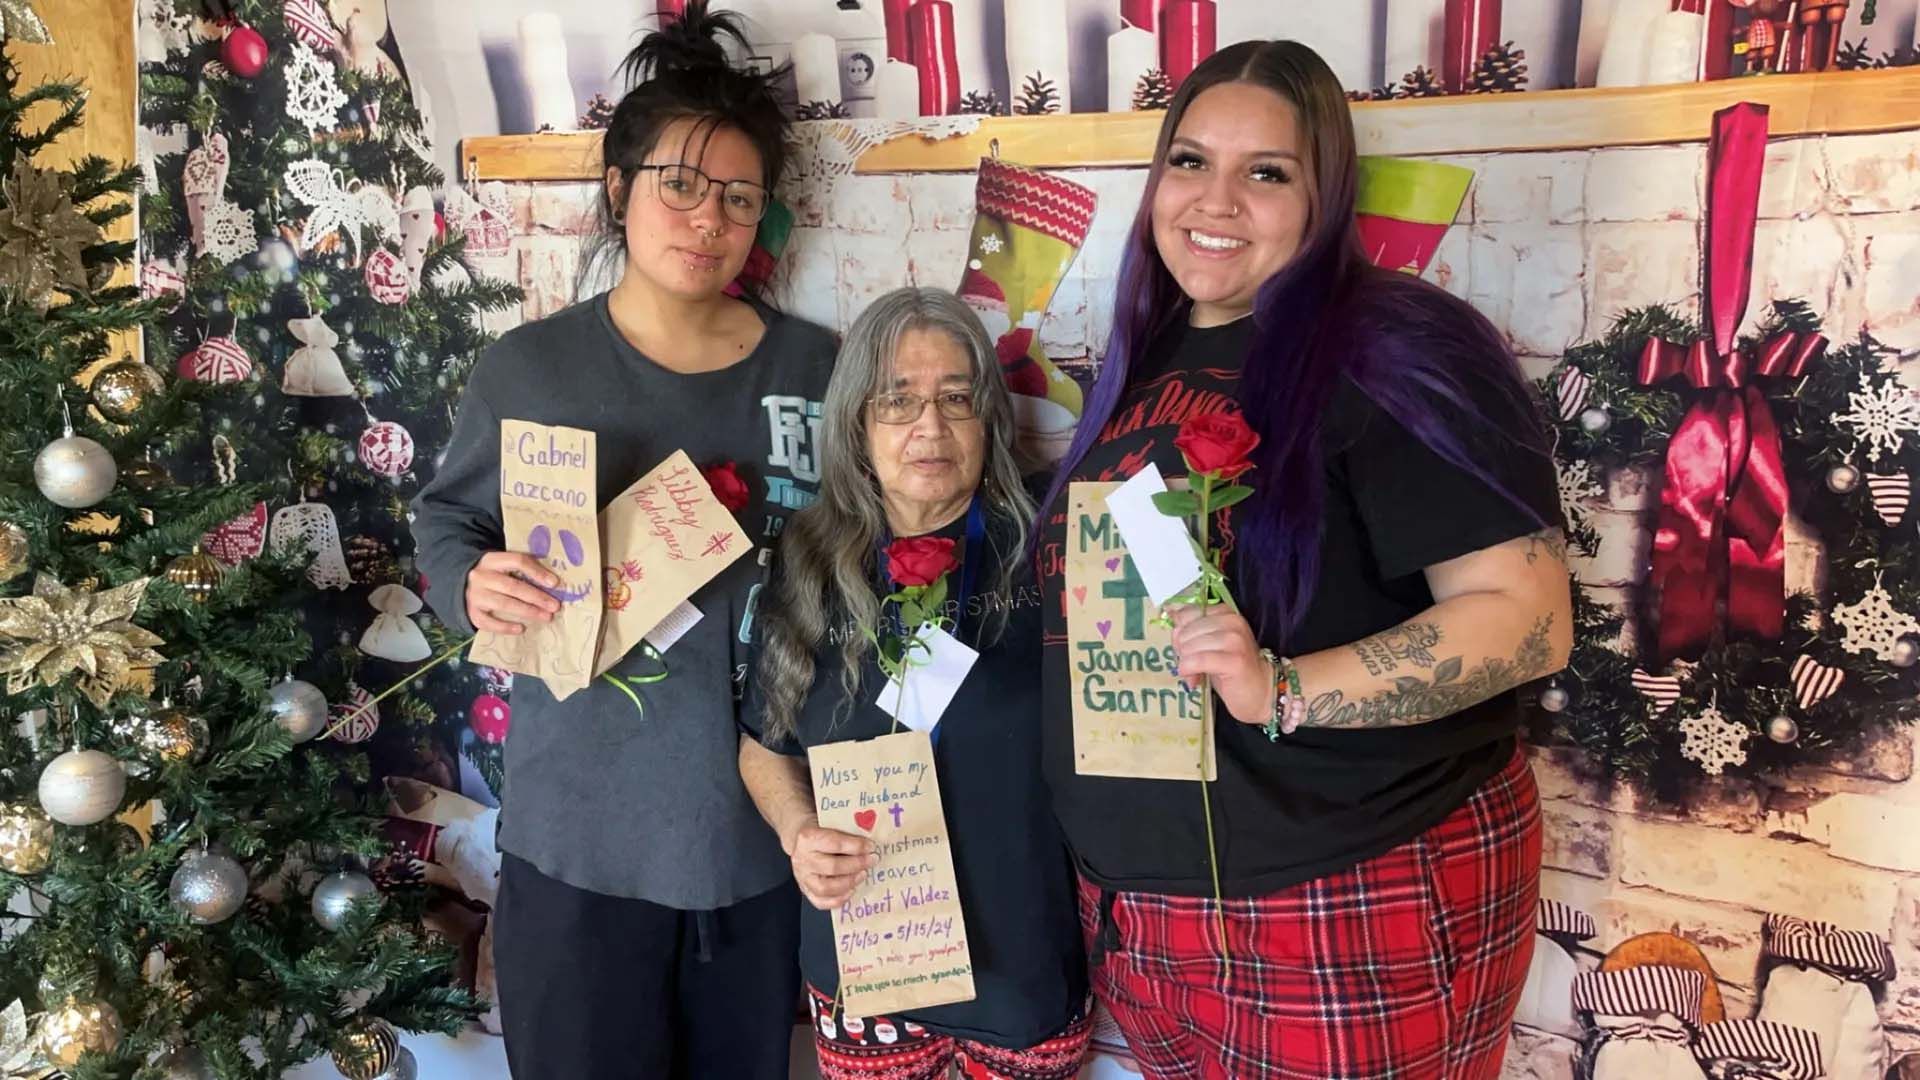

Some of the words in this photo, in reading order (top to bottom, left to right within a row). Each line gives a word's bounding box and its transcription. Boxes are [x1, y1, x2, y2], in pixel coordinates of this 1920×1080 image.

[1100, 397, 1153, 444] ACK
[518, 431, 586, 469] Gabriel
[502, 469, 587, 507] Lazcano
[657, 465, 703, 529] Libby
[763, 514, 785, 538] 19
[1080, 513, 1127, 553] Mi
[1077, 641, 1179, 673] James
[819, 766, 859, 789] Miss
[874, 764, 903, 784] you
[908, 762, 928, 784] my
[821, 796, 850, 811] Dear
[859, 784, 922, 807] Husband
[840, 888, 893, 924] Robert
[901, 885, 950, 909] Valdez
[897, 916, 953, 942] 5/15/24
